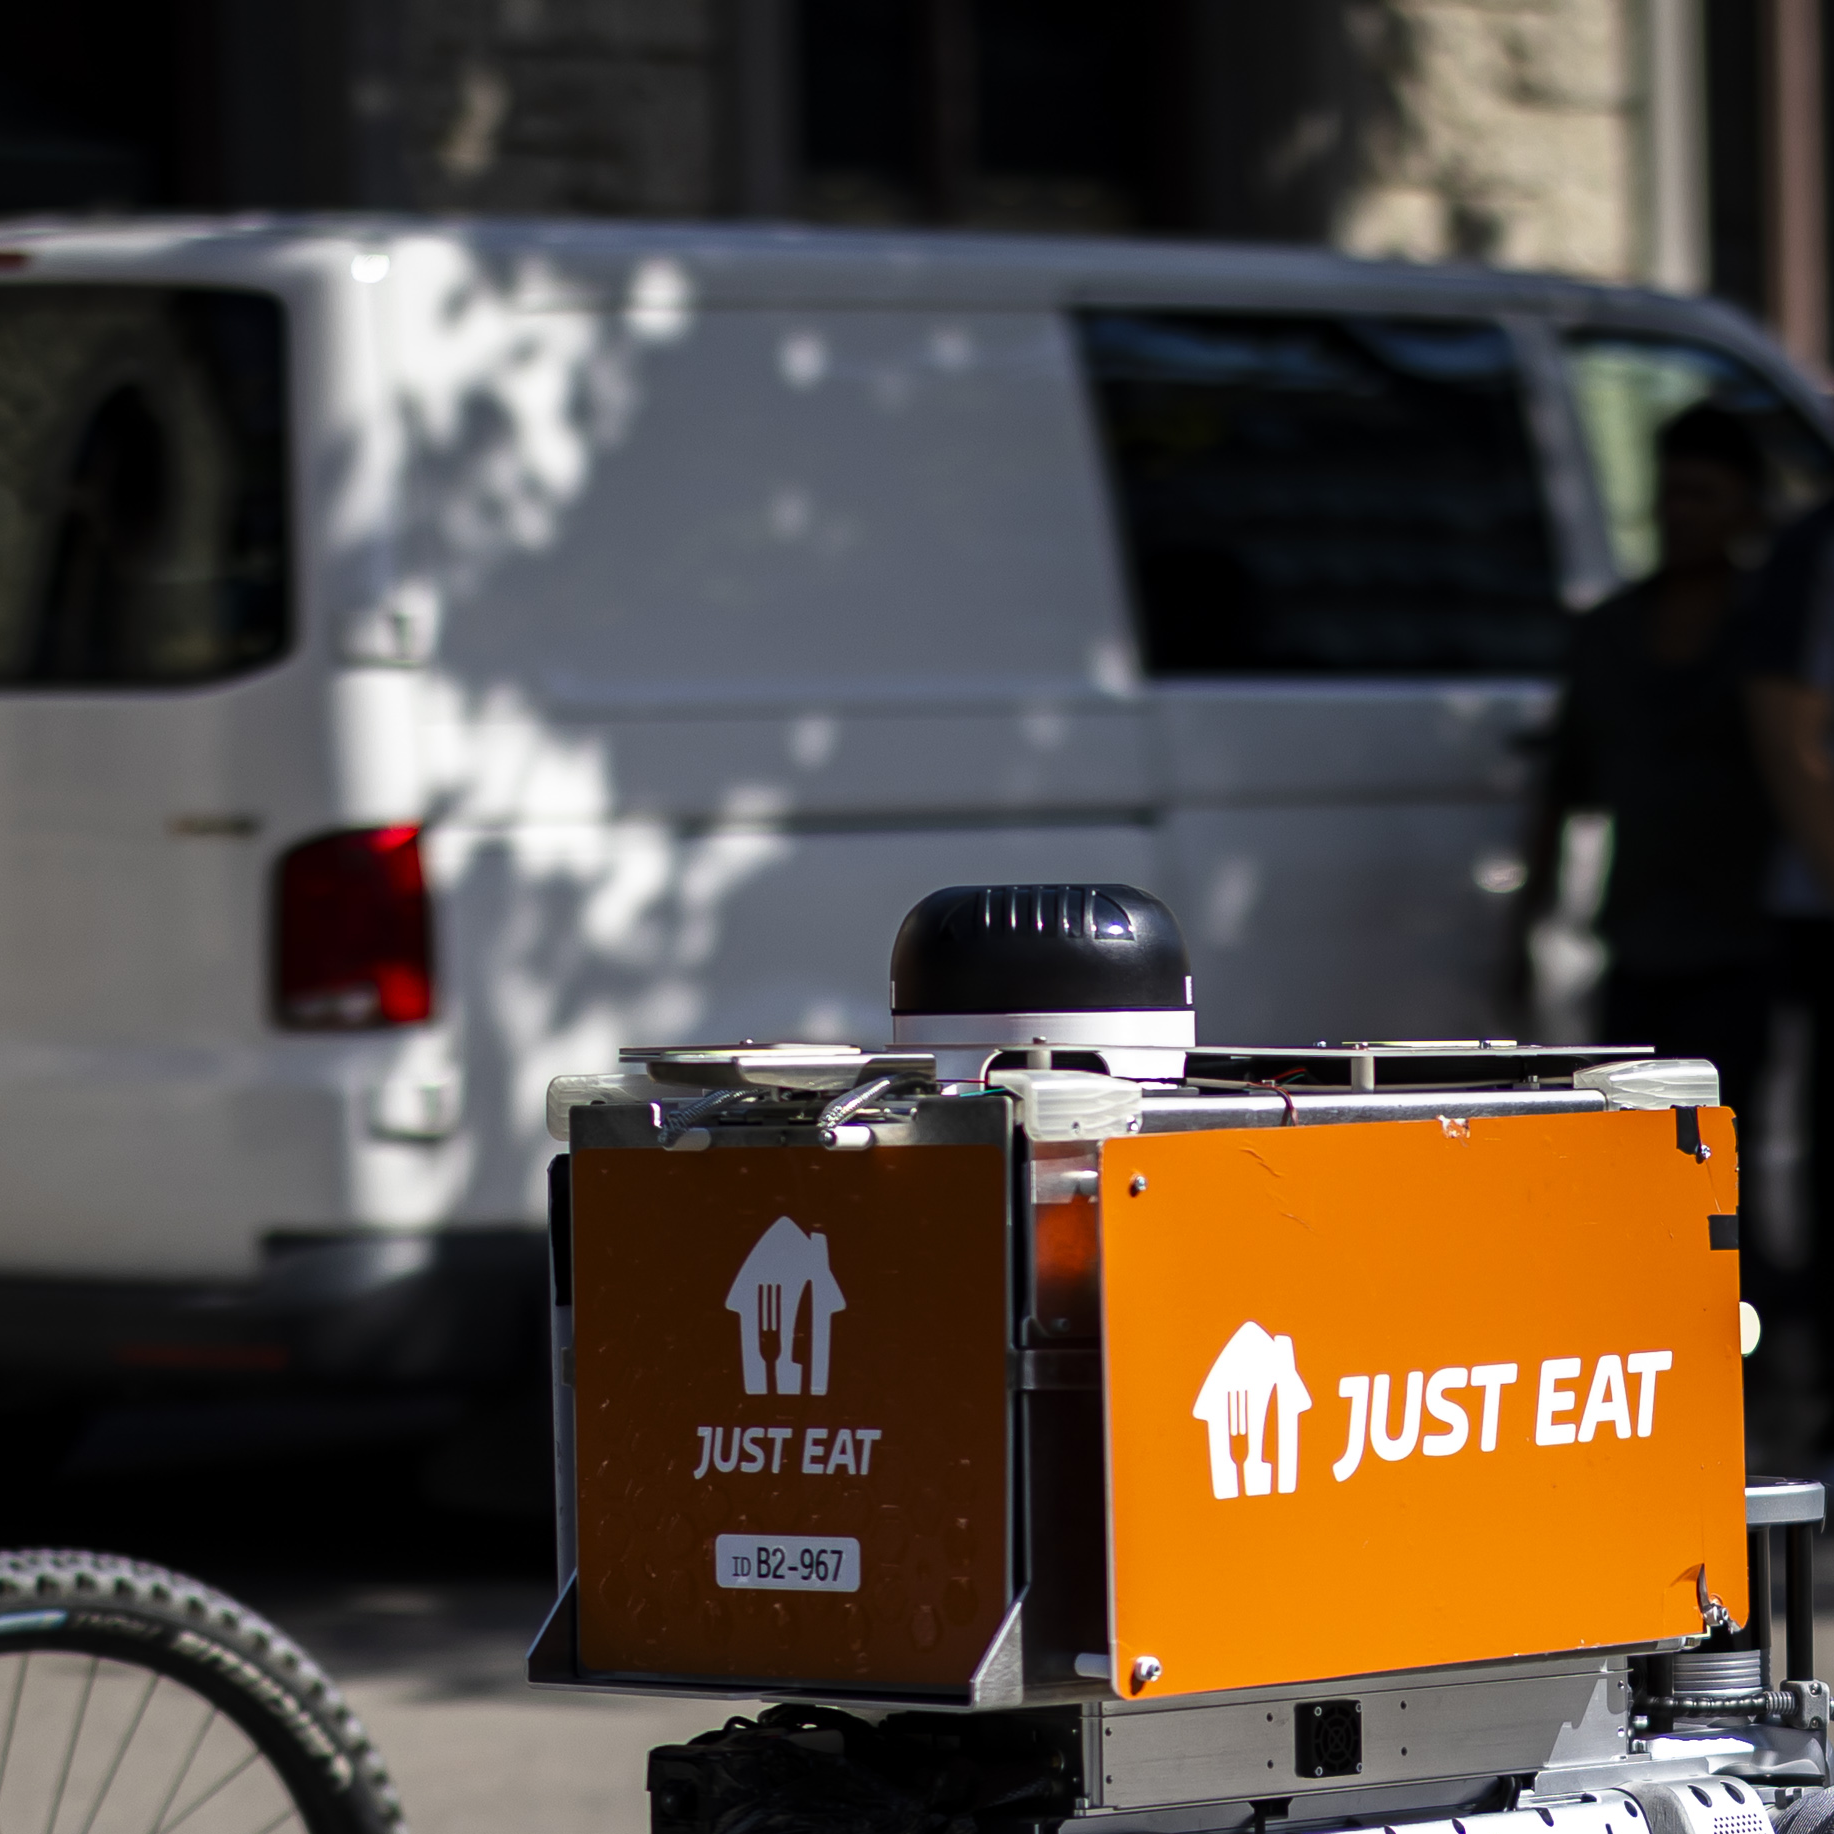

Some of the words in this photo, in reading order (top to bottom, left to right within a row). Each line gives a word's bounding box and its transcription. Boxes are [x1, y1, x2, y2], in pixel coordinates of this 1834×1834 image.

[1332, 1362, 1519, 1483] JUST
[1534, 1350, 1673, 1447] EAT
[693, 1426, 793, 1480] JUST
[801, 1427, 883, 1476] EAT
[731, 1556, 752, 1577] ID
[756, 1546, 844, 1582] B2-967
